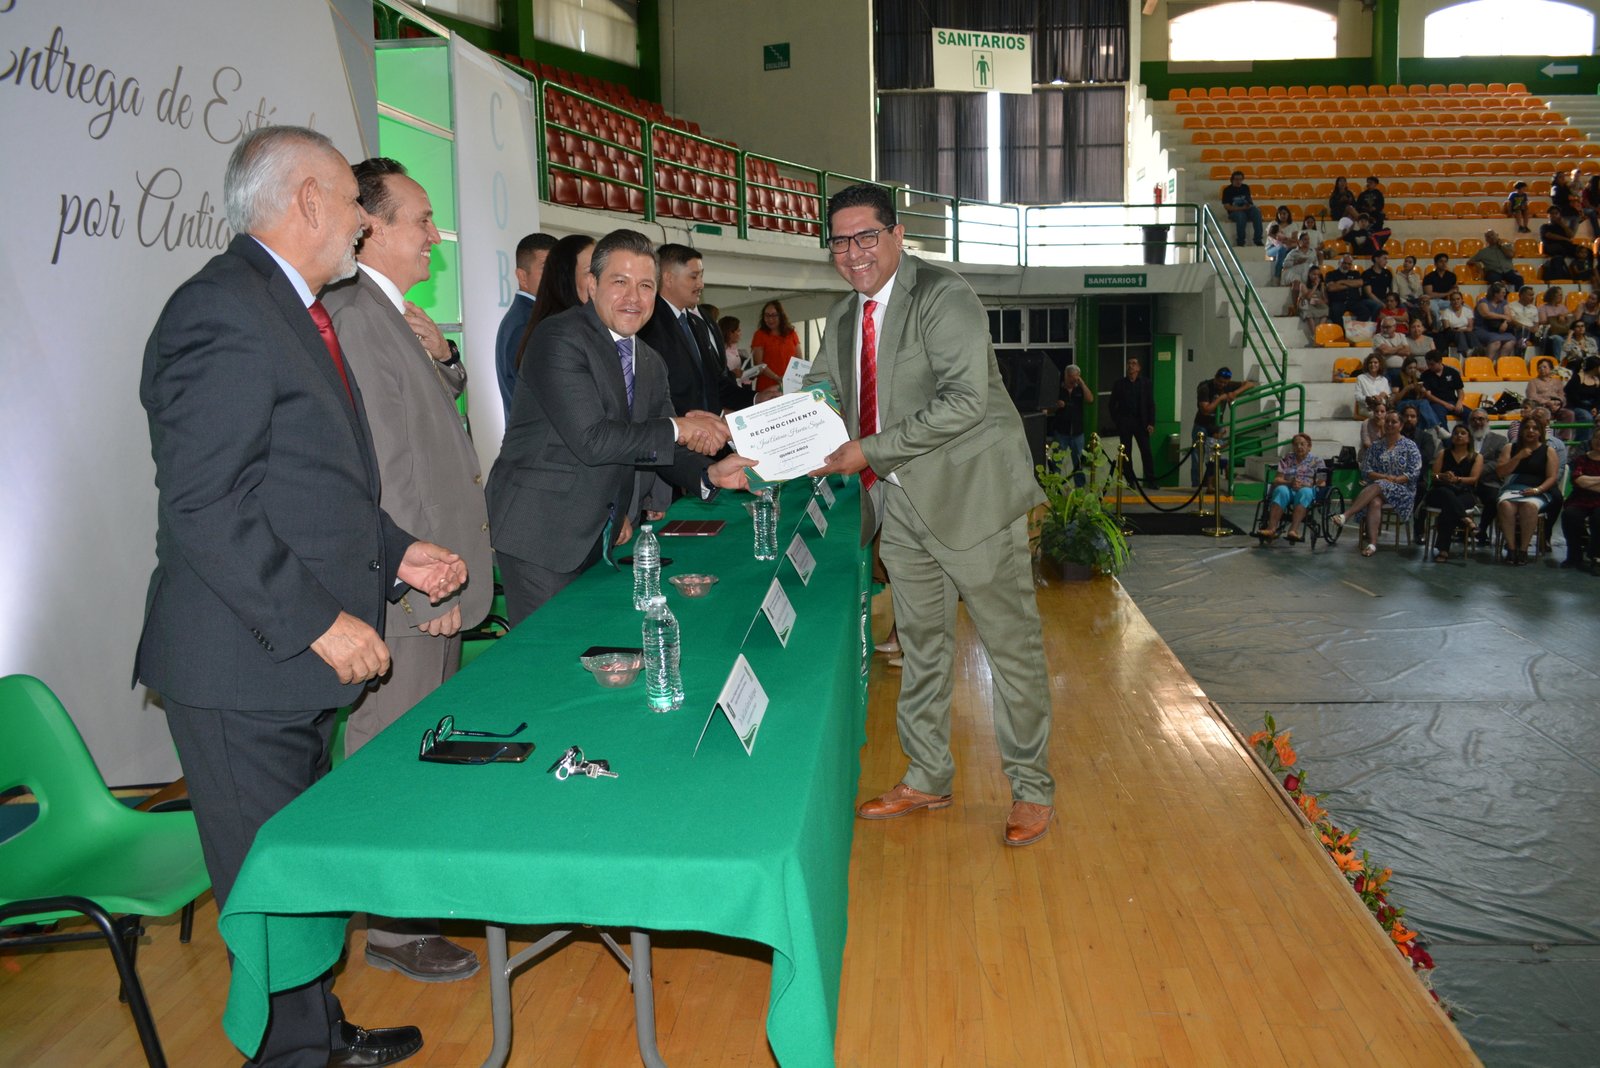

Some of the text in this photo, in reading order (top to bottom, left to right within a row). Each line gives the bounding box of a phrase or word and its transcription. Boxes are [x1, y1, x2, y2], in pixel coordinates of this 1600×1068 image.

[938, 31, 1025, 50] SANITARIOS
[0, 26, 144, 140] ntrega
[157, 65, 194, 129] de
[51, 190, 125, 265] por
[750, 410, 818, 437] RECONOCIMIENTO
